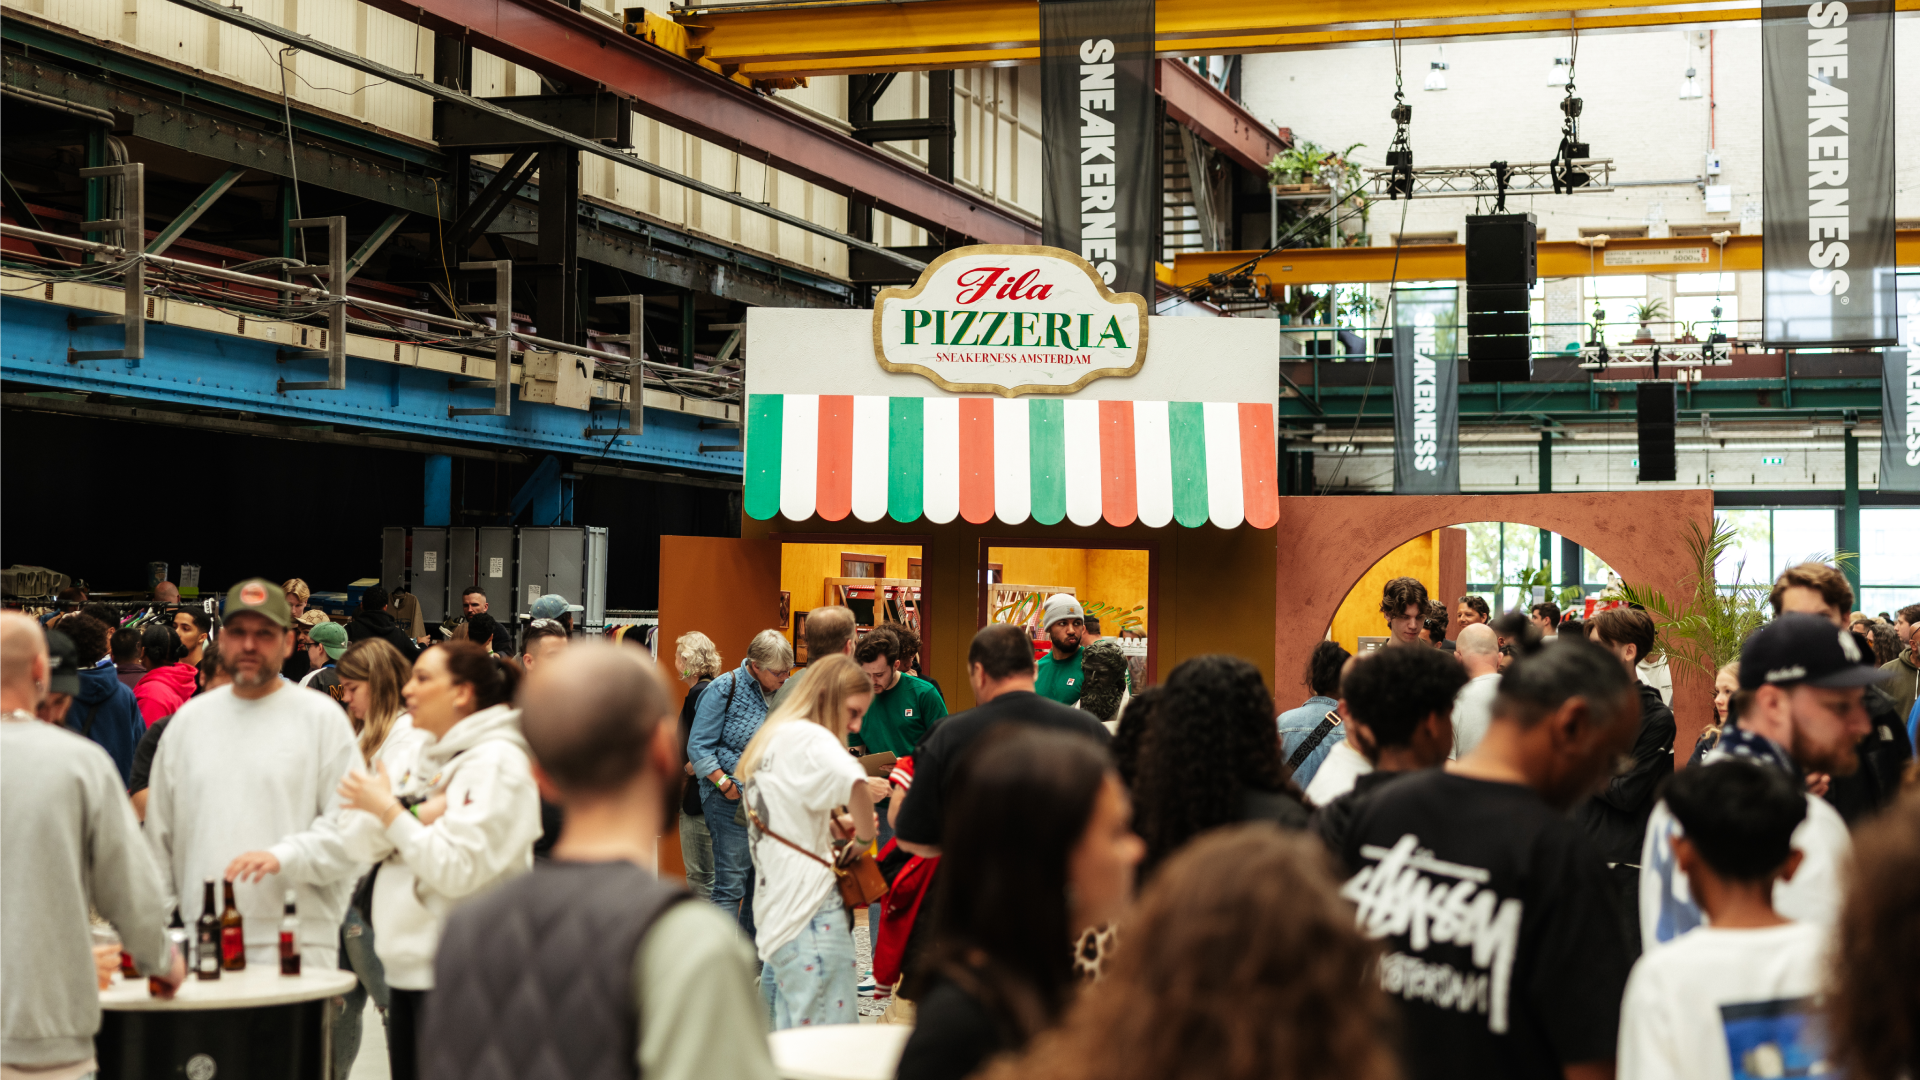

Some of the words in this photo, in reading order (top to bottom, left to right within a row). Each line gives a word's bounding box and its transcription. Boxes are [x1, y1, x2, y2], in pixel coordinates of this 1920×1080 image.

[1079, 38, 1117, 294] SNEAKERNES
[1807, 1, 1850, 296] SNEAKERNESS
[900, 309, 1132, 351] PIZZERIA
[956, 266, 1053, 305] Fila
[935, 352, 1017, 363] SNEAKERNESS
[1018, 353, 1092, 364] AMSTERDAM
[1413, 312, 1437, 471] SNEAKERNESS
